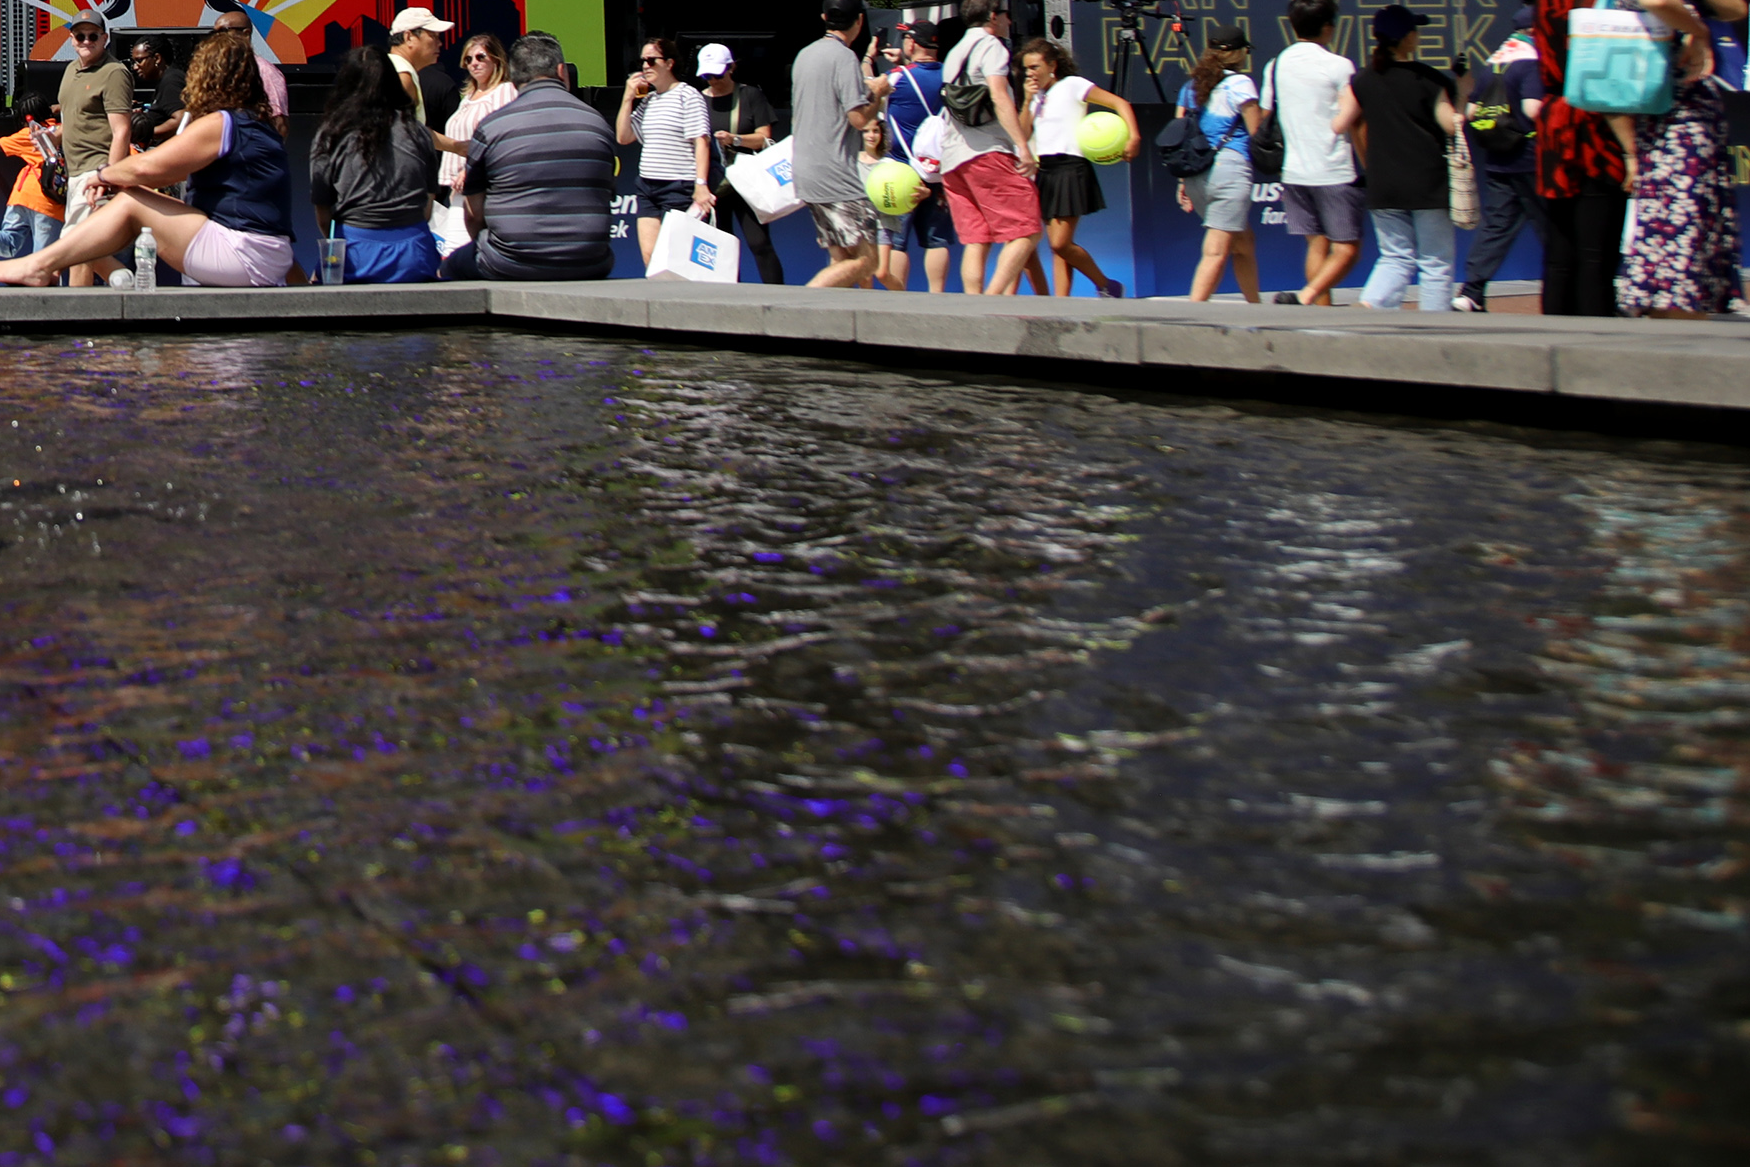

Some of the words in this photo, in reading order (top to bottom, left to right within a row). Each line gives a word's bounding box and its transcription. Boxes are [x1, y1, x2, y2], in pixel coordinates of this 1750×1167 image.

[1250, 182, 1284, 202] us
[609, 194, 638, 214] en
[609, 219, 629, 238] ek
